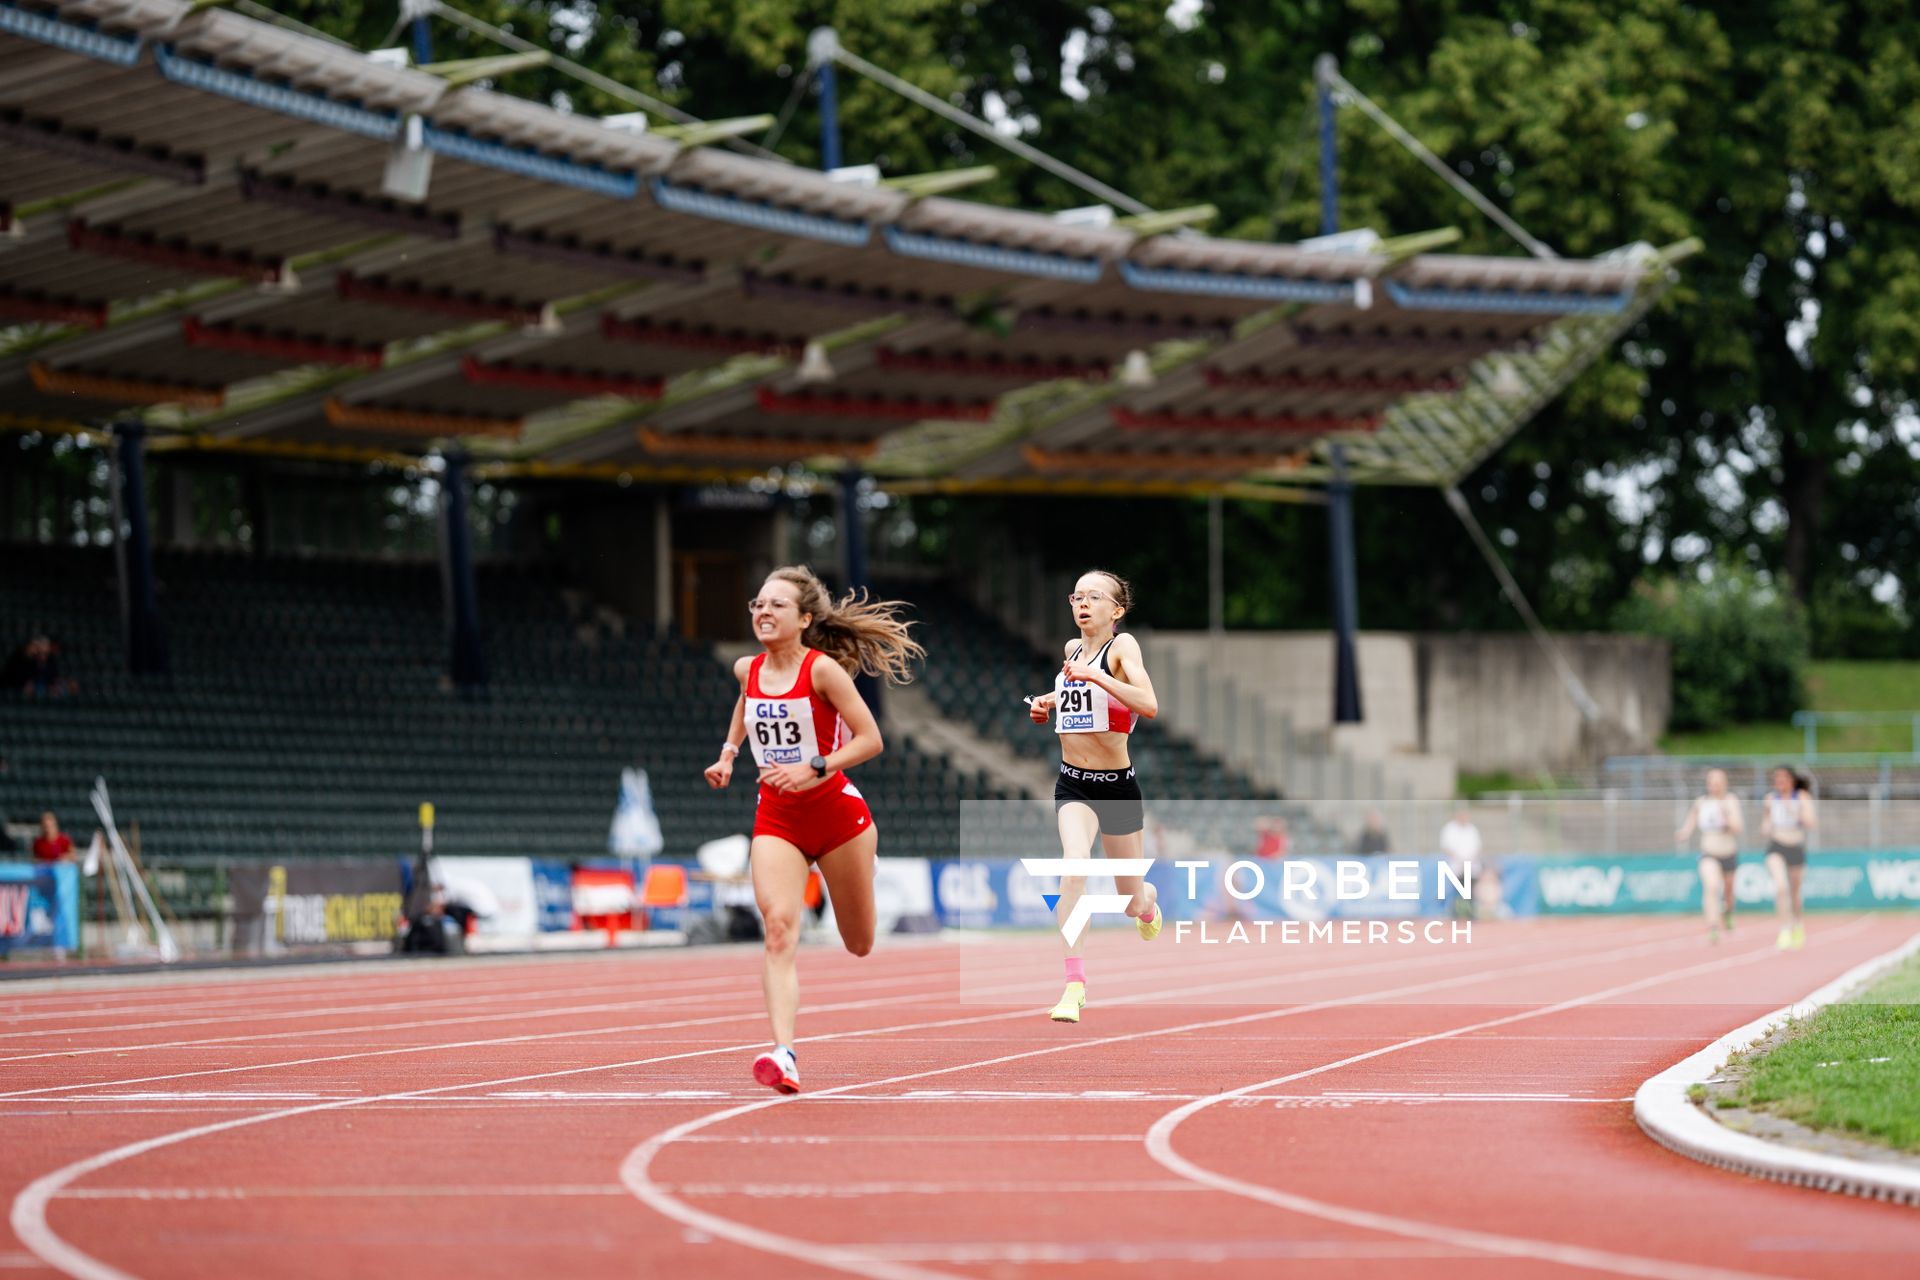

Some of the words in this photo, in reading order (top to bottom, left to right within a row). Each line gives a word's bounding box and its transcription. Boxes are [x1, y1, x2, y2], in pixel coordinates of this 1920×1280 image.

[756, 703, 788, 719] GLS
[1060, 689, 1093, 713] 291
[755, 721, 802, 746] 613
[1082, 772, 1118, 782] PRO
